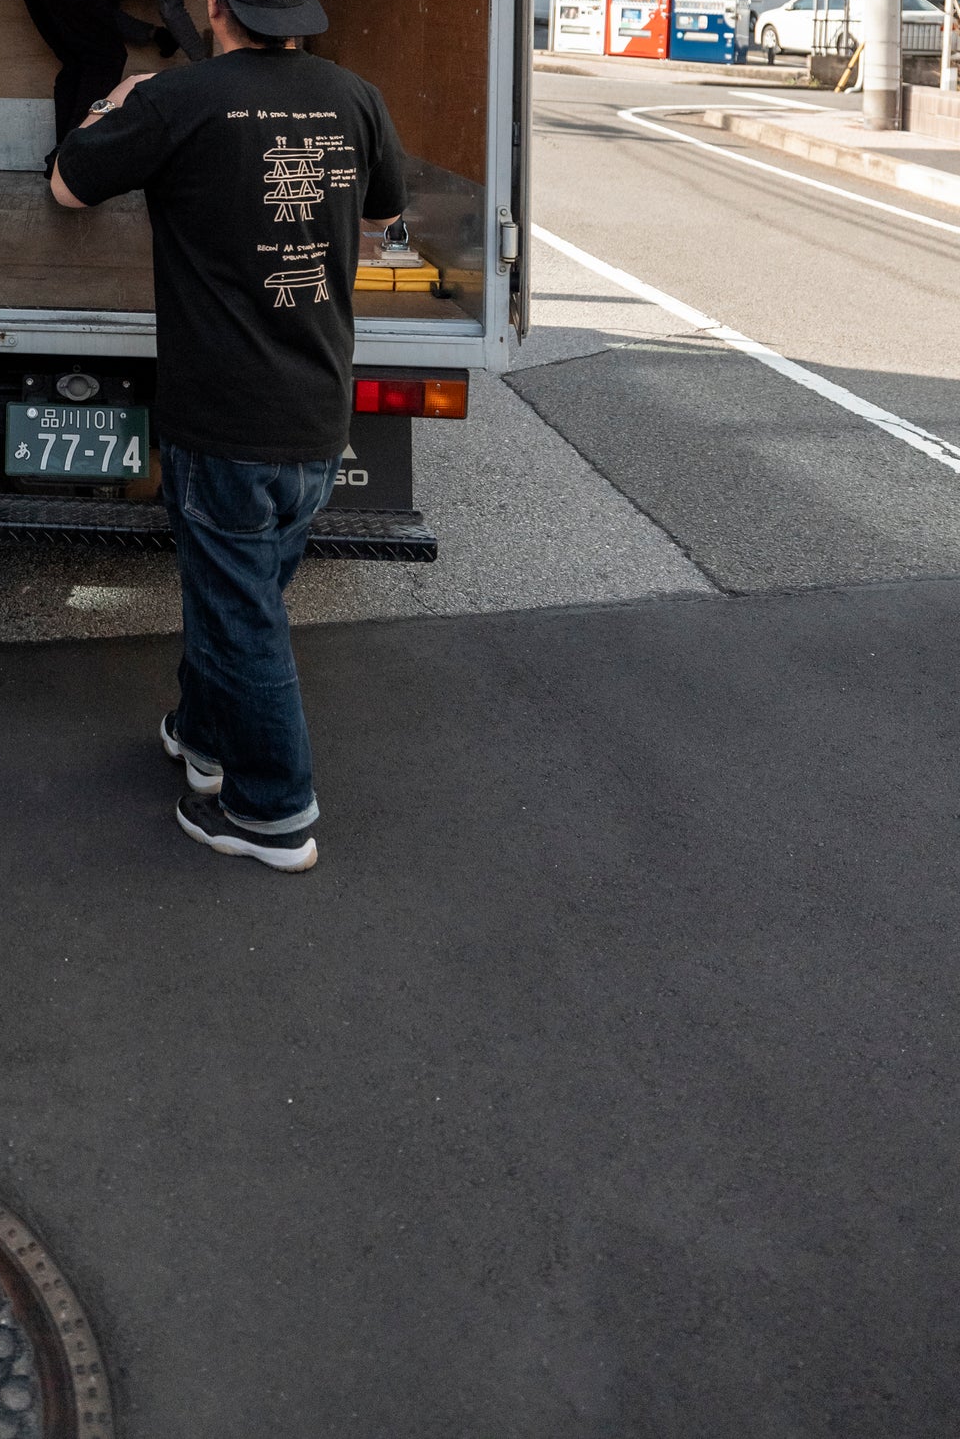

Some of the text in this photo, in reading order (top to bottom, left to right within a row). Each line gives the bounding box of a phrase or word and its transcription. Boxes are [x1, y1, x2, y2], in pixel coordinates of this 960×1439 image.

[257, 243, 279, 252] RECON
[41, 409, 114, 429] 品川 101
[14, 433, 142, 473] あ 77-74
[333, 469, 369, 486] SO
